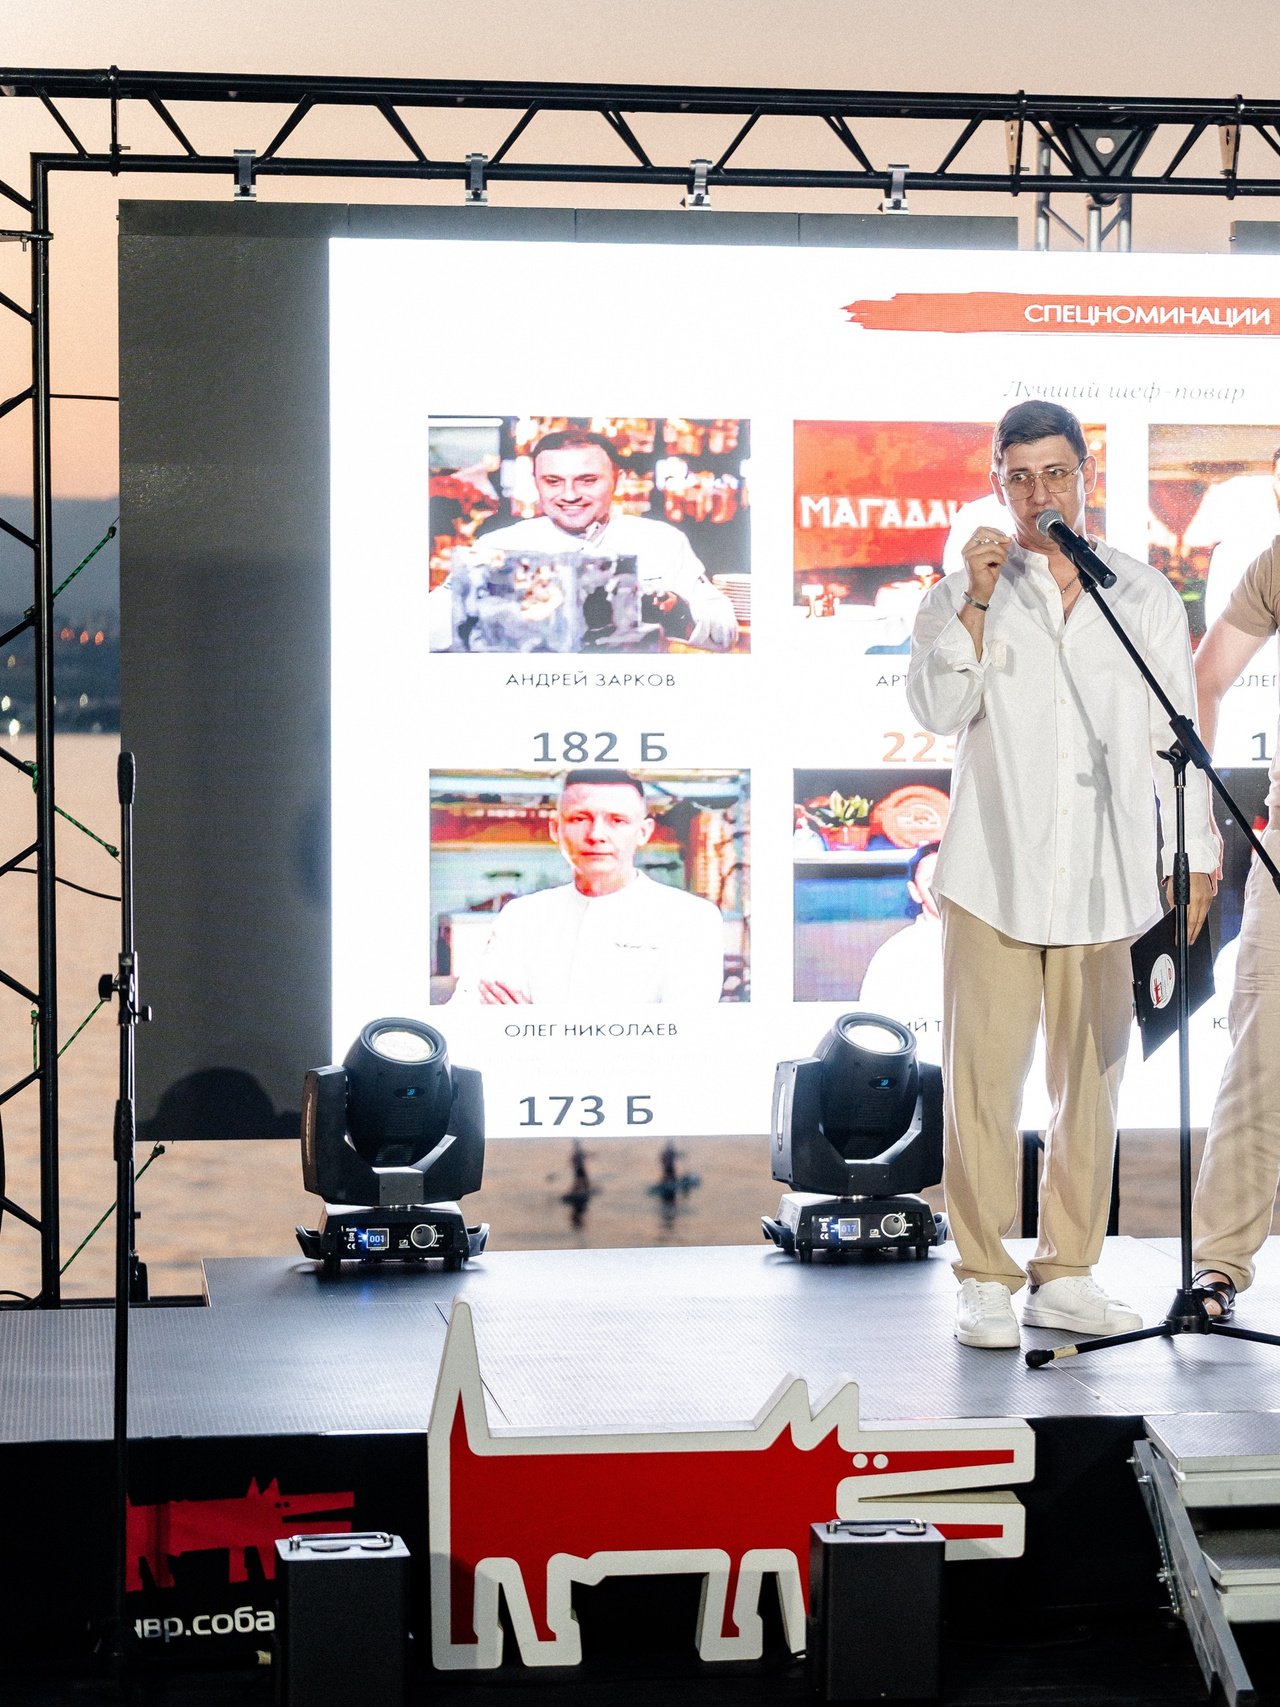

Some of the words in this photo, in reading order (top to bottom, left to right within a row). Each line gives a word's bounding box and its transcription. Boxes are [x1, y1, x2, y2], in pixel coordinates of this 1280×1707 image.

[1024, 303, 1271, 328] СПЕЦНОМИНАЦИИ
[1003, 380, 1101, 400] Лучший
[1108, 381, 1246, 404] шеф-повар
[506, 671, 588, 690] АНДРЕЙ
[594, 673, 676, 688] ЗАРКОВ
[876, 674, 907, 687] АРТ
[534, 731, 619, 763] 182
[641, 732, 668, 763] Б
[505, 1024, 557, 1038] ОЛЕГ
[564, 1023, 678, 1038] НИКОЛАЕВ
[517, 1095, 606, 1127] 173
[627, 1095, 655, 1126] Б
[841, 1224, 857, 1233] 017
[369, 1234, 385, 1243] 001
